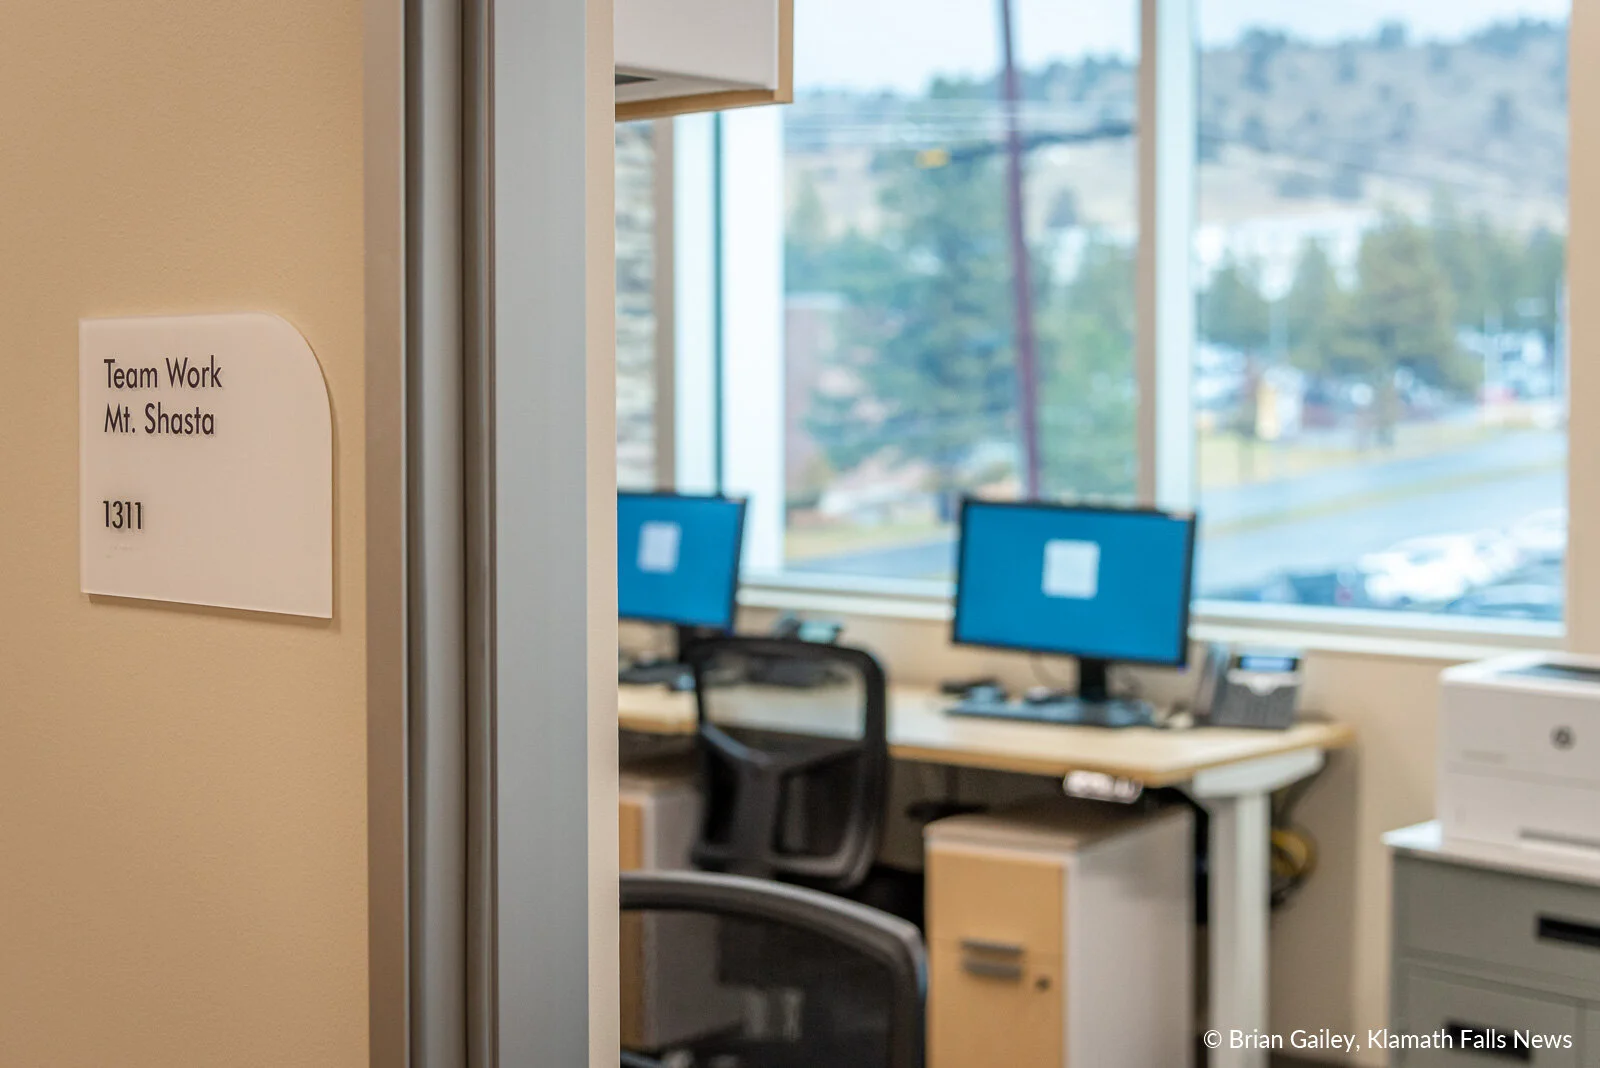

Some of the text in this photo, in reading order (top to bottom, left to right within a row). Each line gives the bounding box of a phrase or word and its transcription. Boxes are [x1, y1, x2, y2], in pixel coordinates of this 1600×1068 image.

[104, 355, 223, 389] Team Work
[104, 402, 215, 435] Mt. Shasta
[103, 500, 143, 530] 1311
